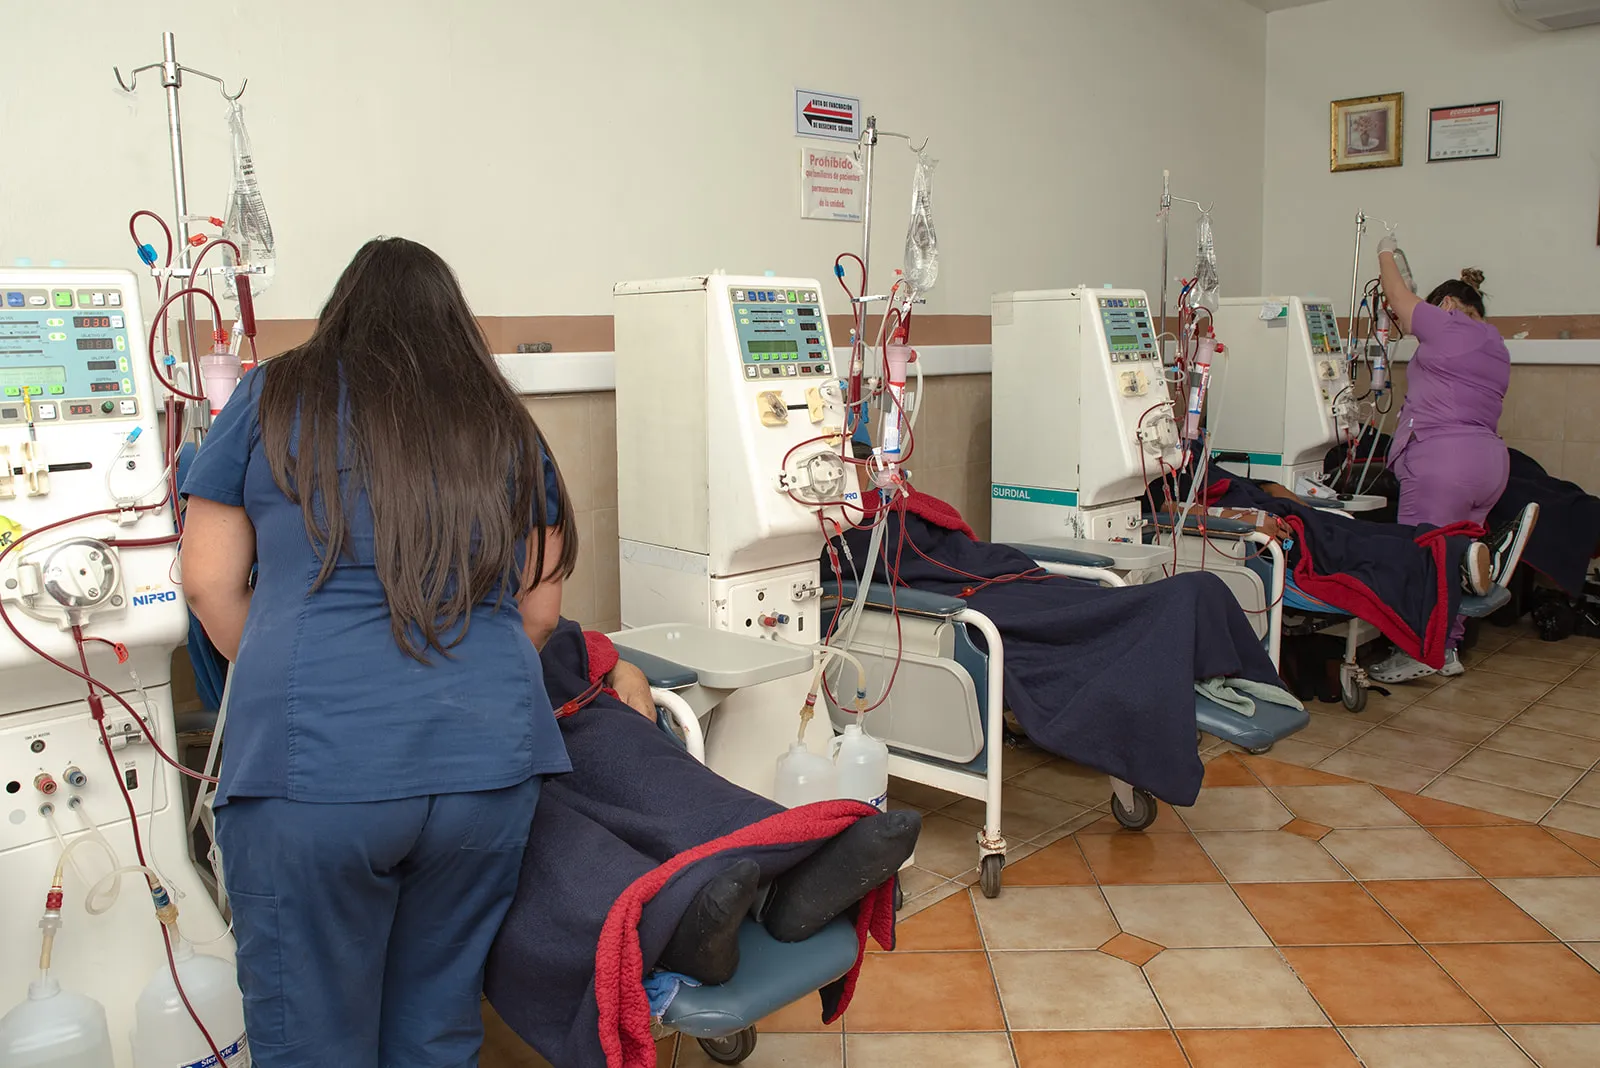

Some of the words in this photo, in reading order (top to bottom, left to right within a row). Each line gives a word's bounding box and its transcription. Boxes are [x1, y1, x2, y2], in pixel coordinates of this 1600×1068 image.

[812, 99, 822, 107] RUTA
[810, 154, 853, 170] Prohibido
[844, 492, 858, 501] PRO
[993, 486, 1031, 500] SURDIAL
[132, 590, 177, 607] NIPRO
